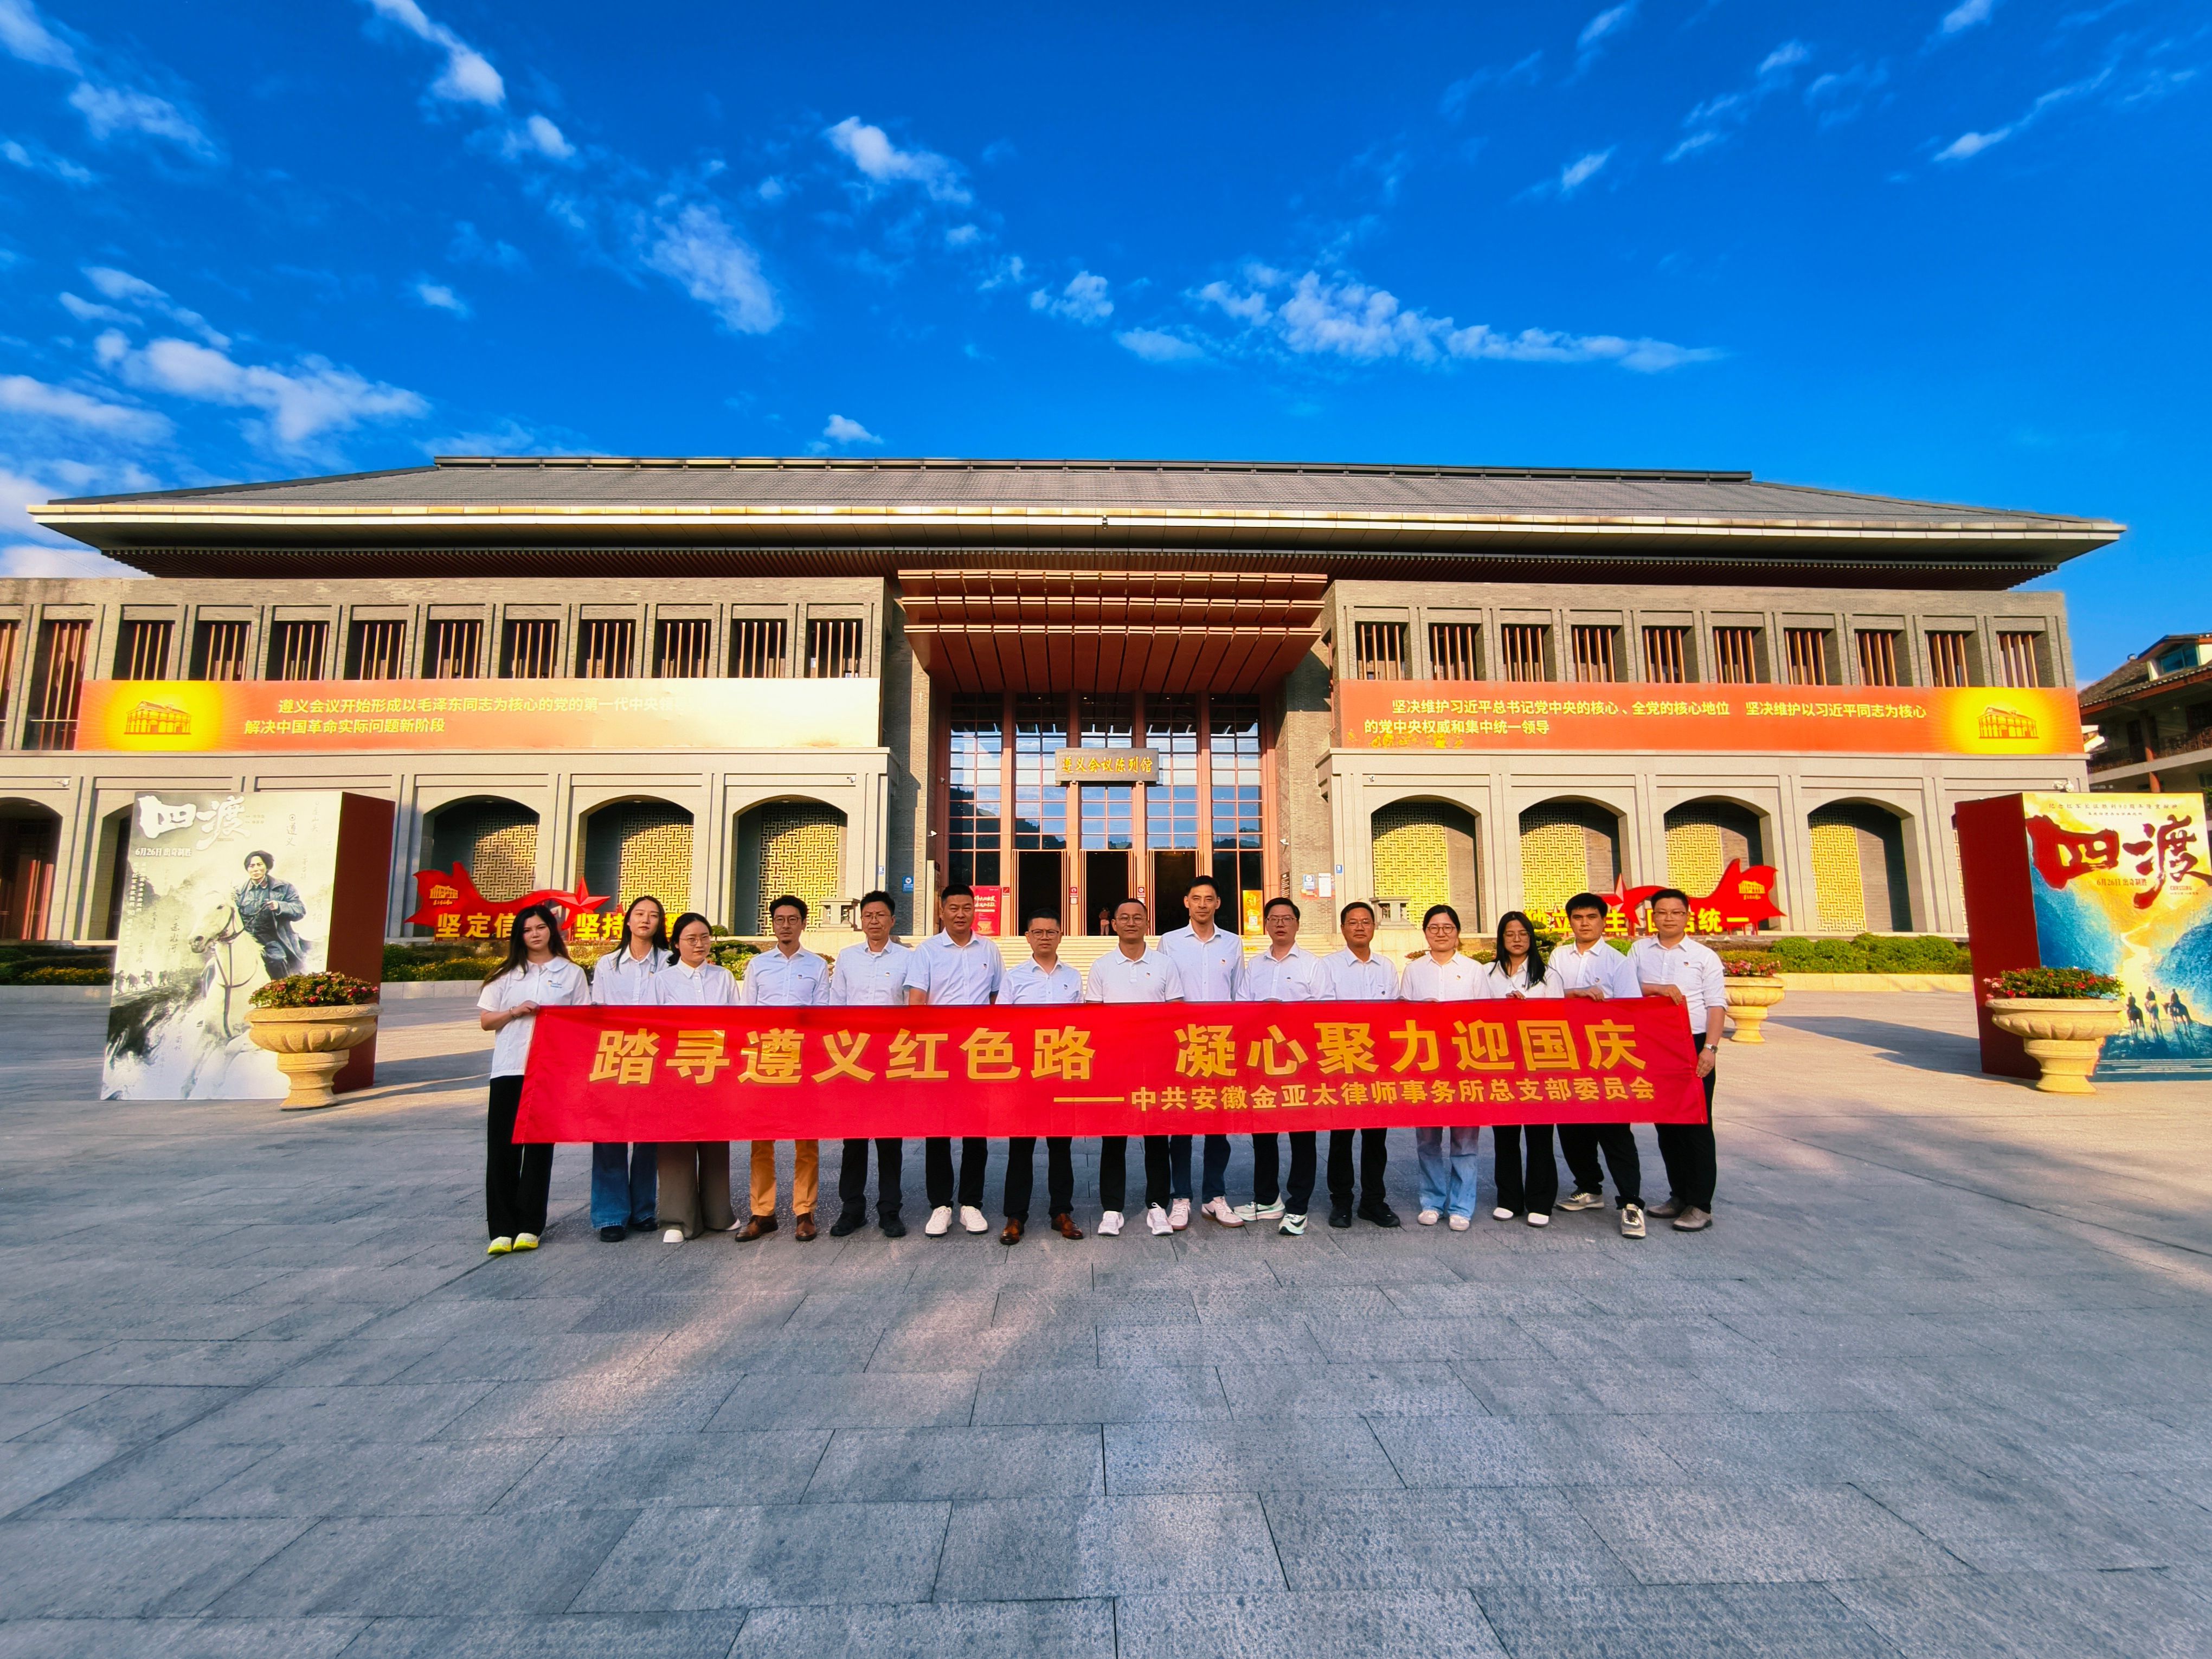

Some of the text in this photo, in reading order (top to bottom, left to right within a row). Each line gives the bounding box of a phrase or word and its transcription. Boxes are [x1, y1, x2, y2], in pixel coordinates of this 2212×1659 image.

[279, 696, 684, 715] 遵义会议开始形成以毛泽东同志为核心的党的第一代中央领
[1392, 699, 1927, 719] 坚决维护习近平总书记党中央的核心、全党的核心地位 坚决维护以习近平同志为核心
[244, 719, 446, 735] 解决中国革命实际问题新阶段
[1364, 719, 1550, 735] 的党中央权威和集中统一领导
[1062, 755, 1153, 773] 遵义会议陈列馆
[138, 795, 251, 851] 四渡
[135, 847, 162, 857] 6月26日
[2026, 814, 2212, 910] 四渡
[436, 912, 516, 938] 坚定信
[1524, 908, 1628, 933] 独立主
[589, 1019, 1647, 1085] 踏寻遵义红色路 凝心聚力迎国庆
